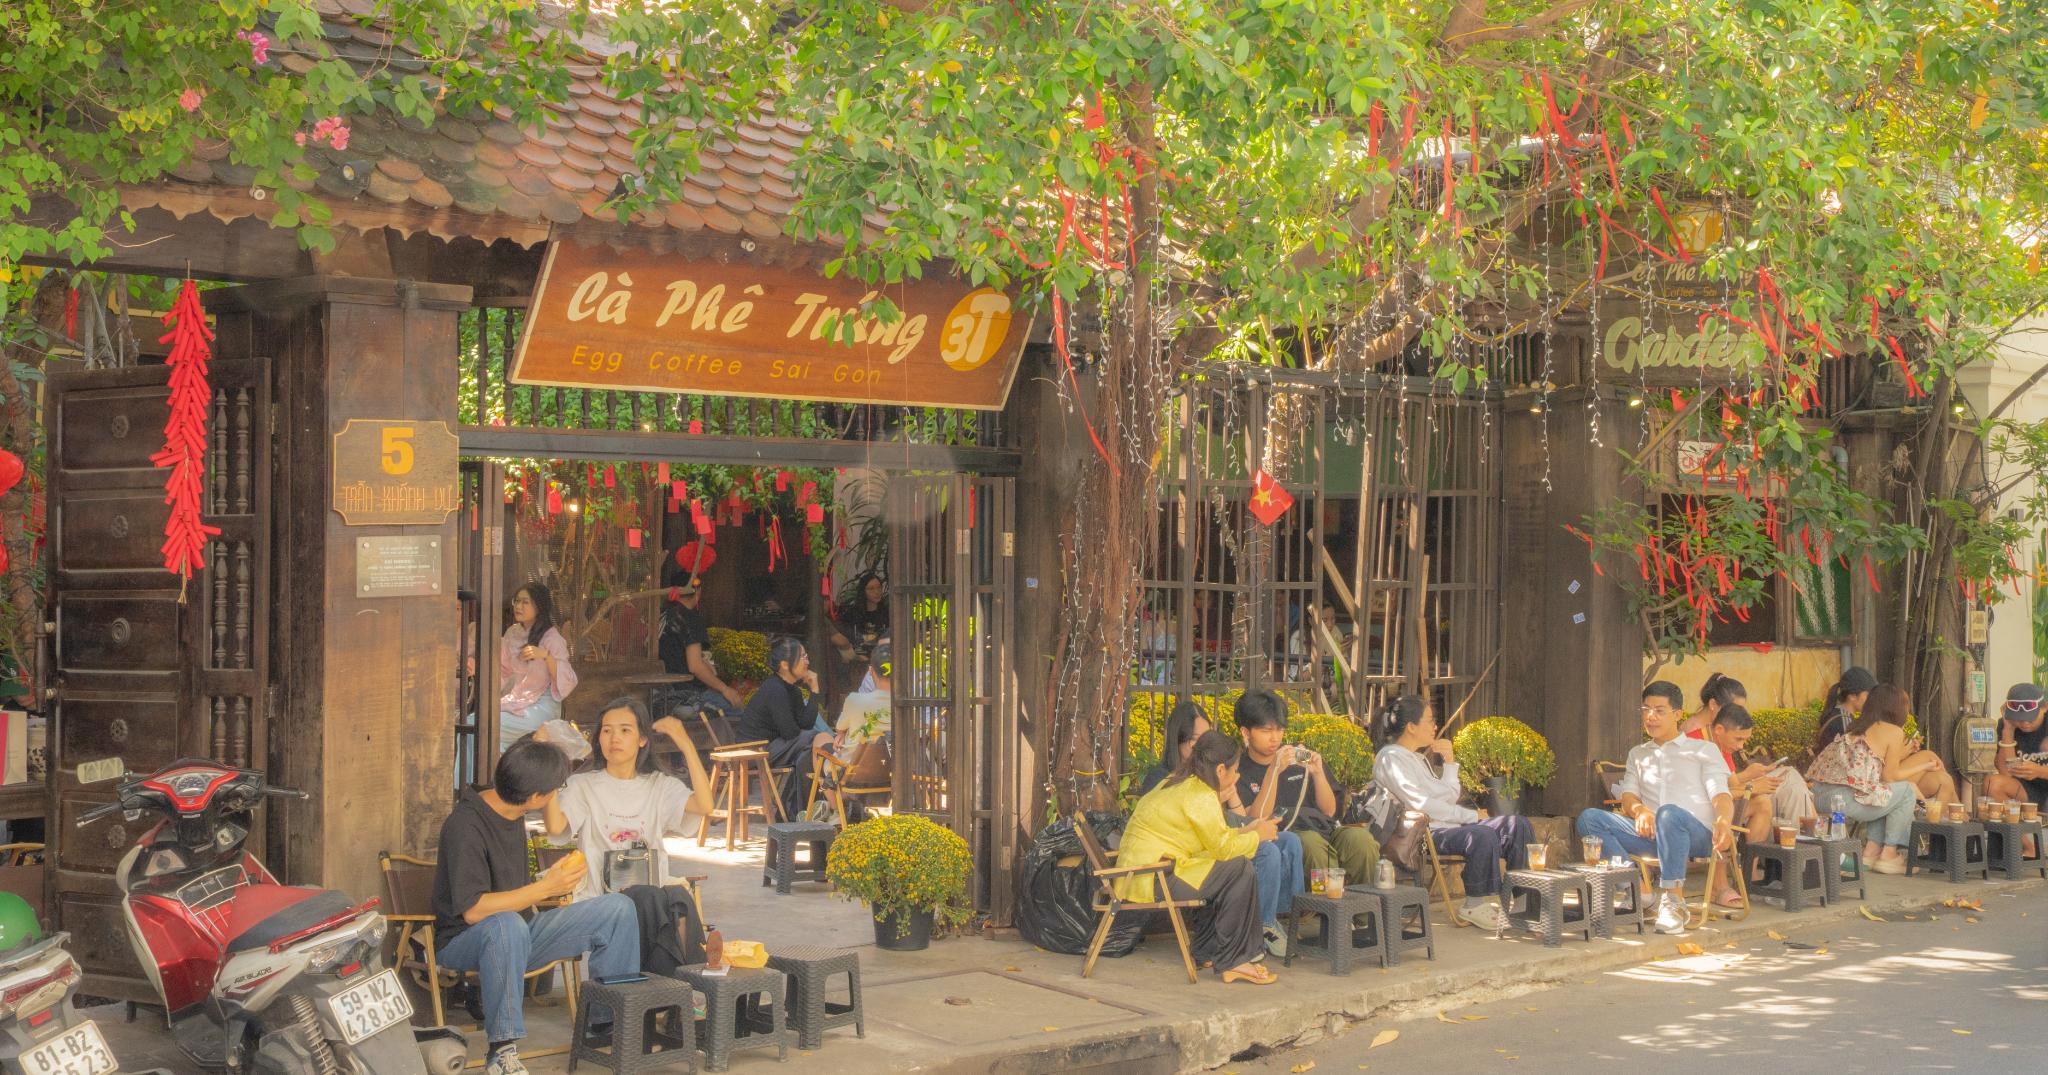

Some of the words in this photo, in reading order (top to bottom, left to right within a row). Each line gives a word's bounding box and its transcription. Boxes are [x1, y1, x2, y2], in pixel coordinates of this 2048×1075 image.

[566, 270, 633, 324] Cà
[655, 279, 766, 333] Phê
[940, 292, 1011, 364] 3T
[570, 345, 623, 373] Egg
[649, 350, 743, 376] Coffee
[769, 359, 810, 380] Sai
[833, 364, 882, 385] Gon
[381, 427, 415, 475] 5
[340, 977, 392, 1016] 59-N2
[34, 1030, 93, 1072] 81-B2
